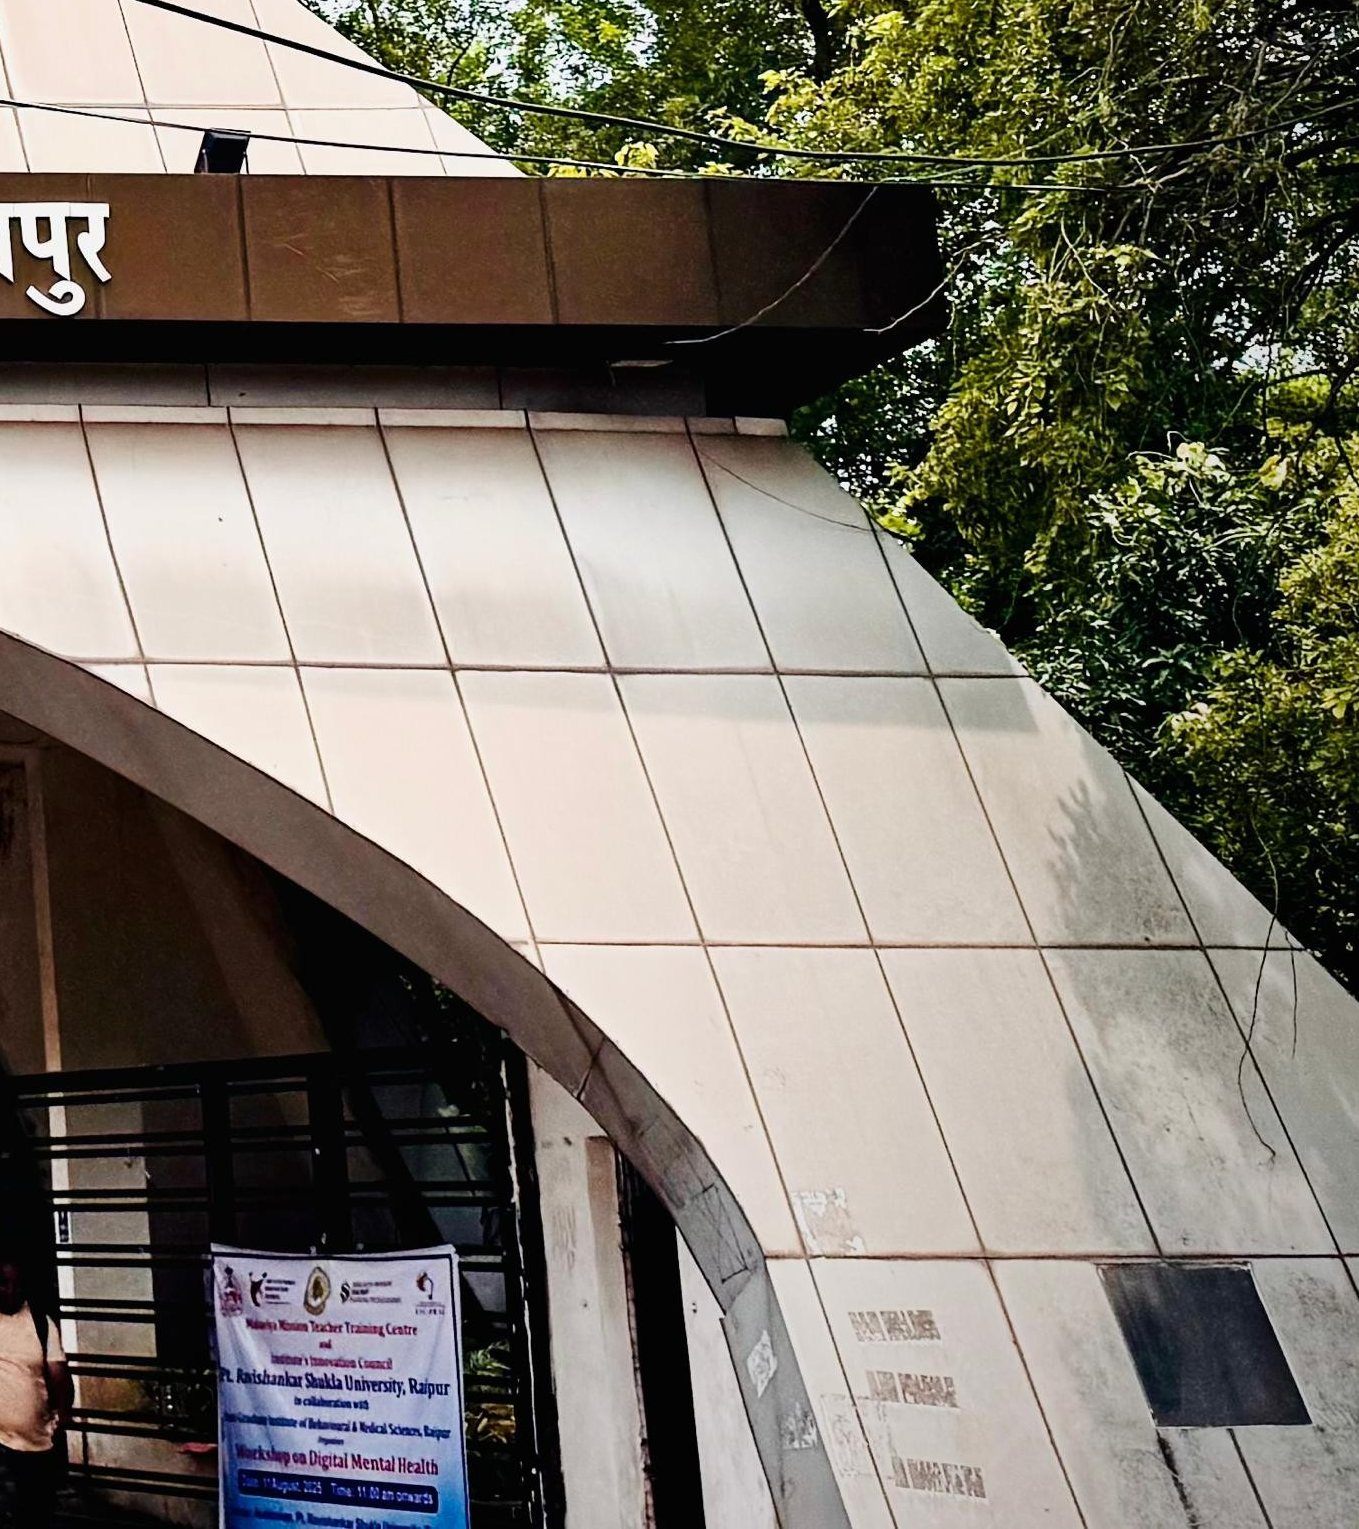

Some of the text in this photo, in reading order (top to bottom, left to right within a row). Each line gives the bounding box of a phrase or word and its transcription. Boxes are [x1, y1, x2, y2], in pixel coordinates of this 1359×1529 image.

[345, 1321, 386, 1337] Training
[386, 1323, 418, 1336] Centre
[305, 1372, 343, 1390] Shukla
[345, 1375, 406, 1398] University,
[408, 1378, 451, 1399] Raipur
[292, 1451, 307, 1465] on
[309, 1449, 348, 1471] Digital
[351, 1453, 395, 1472] Mental
[398, 1457, 439, 1475] Health
[381, 1490, 395, 1501] am
